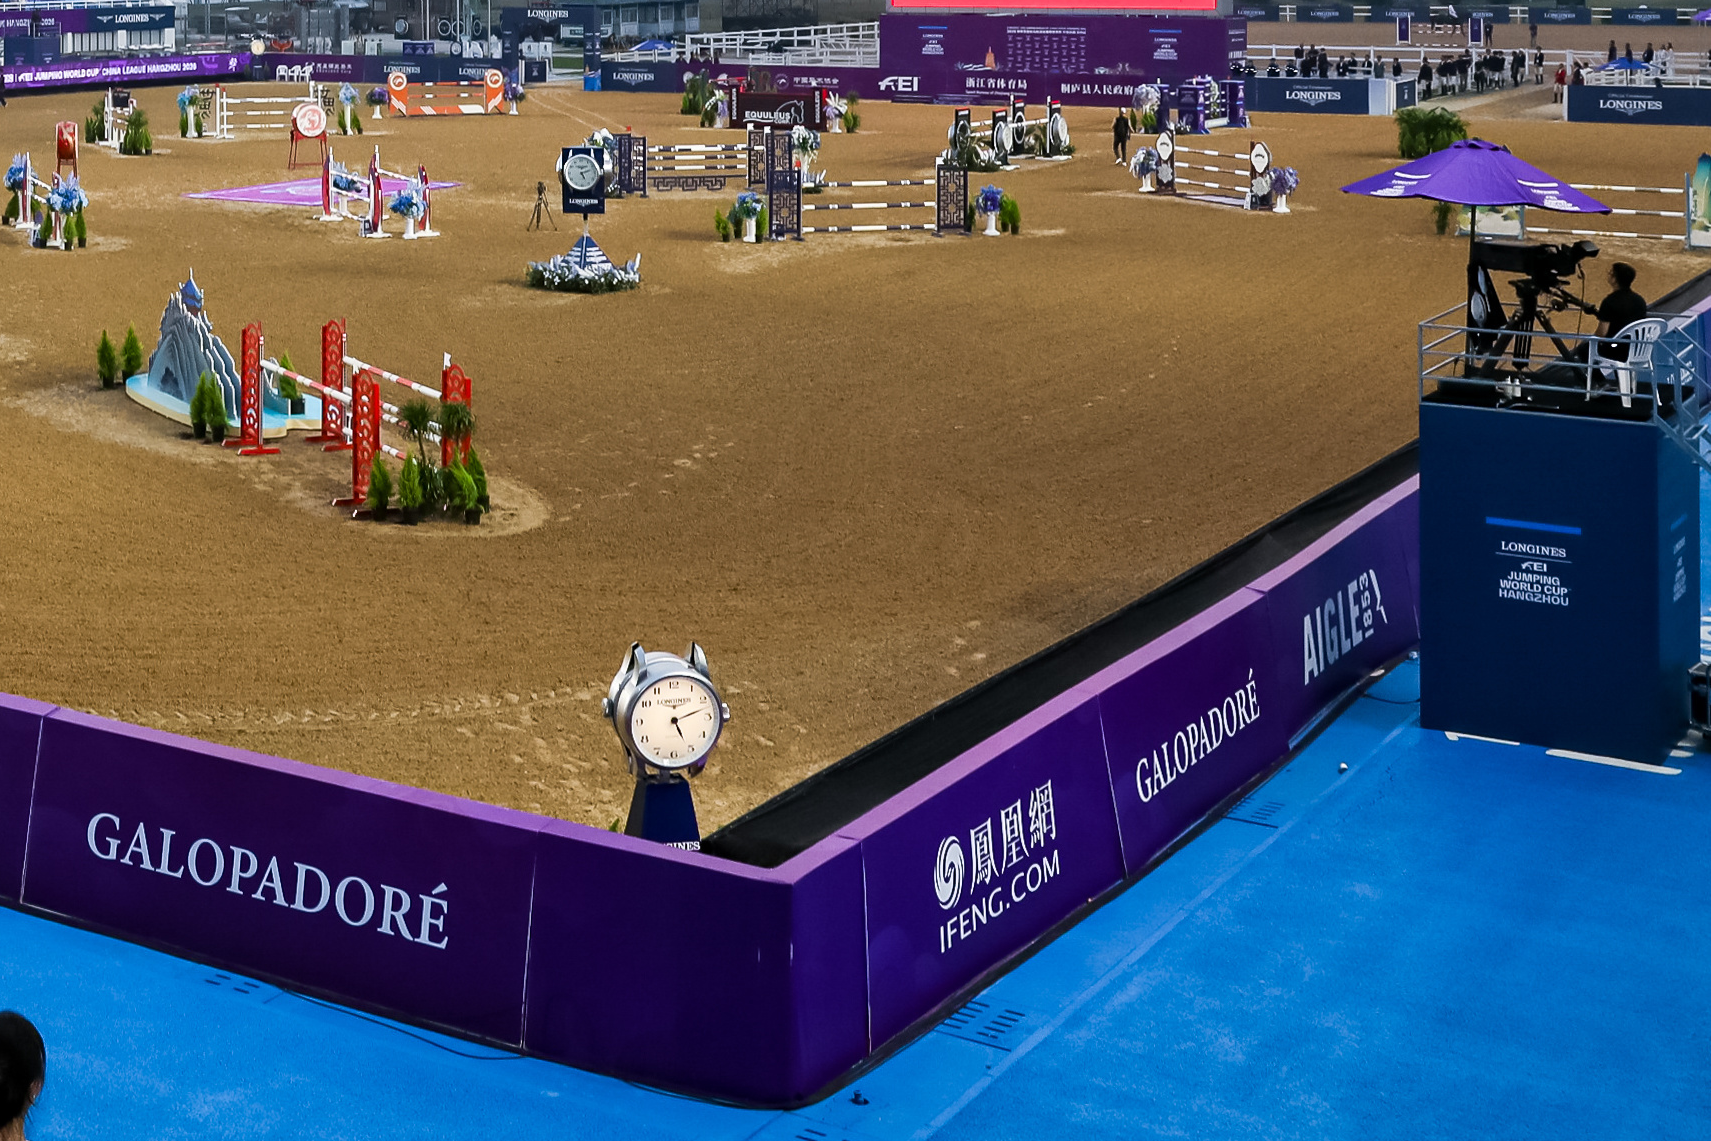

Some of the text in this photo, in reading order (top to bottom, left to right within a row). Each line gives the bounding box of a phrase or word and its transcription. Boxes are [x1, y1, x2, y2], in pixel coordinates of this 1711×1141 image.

[114, 13, 150, 23] LONGINES
[527, 9, 569, 18] LONGINES
[63, 68, 86, 79] WORLD
[102, 65, 121, 76] CHINA
[122, 64, 147, 75] LEAGUE
[383, 65, 421, 74] LONGINES
[613, 72, 655, 81] LONGINES
[1285, 90, 1341, 101] LONGINES
[1599, 99, 1663, 110] LONGINES
[744, 111, 791, 120] EQUULEUS
[1500, 540, 1567, 558] LONGINES
[1507, 570, 1561, 586] JUMPING
[1499, 578, 1569, 596] WORLD CUP
[1358, 572, 1374, 639] 1853
[1497, 588, 1570, 607] HANGZHOU
[1302, 577, 1365, 686] AIGLE
[656, 697, 692, 705] LONGINES
[1136, 668, 1261, 803] GALOPADORÉ
[969, 778, 1058, 896] 鳳凰網
[87, 812, 451, 951] GALOPADORÉ
[939, 849, 1061, 954] IFENG.COM
